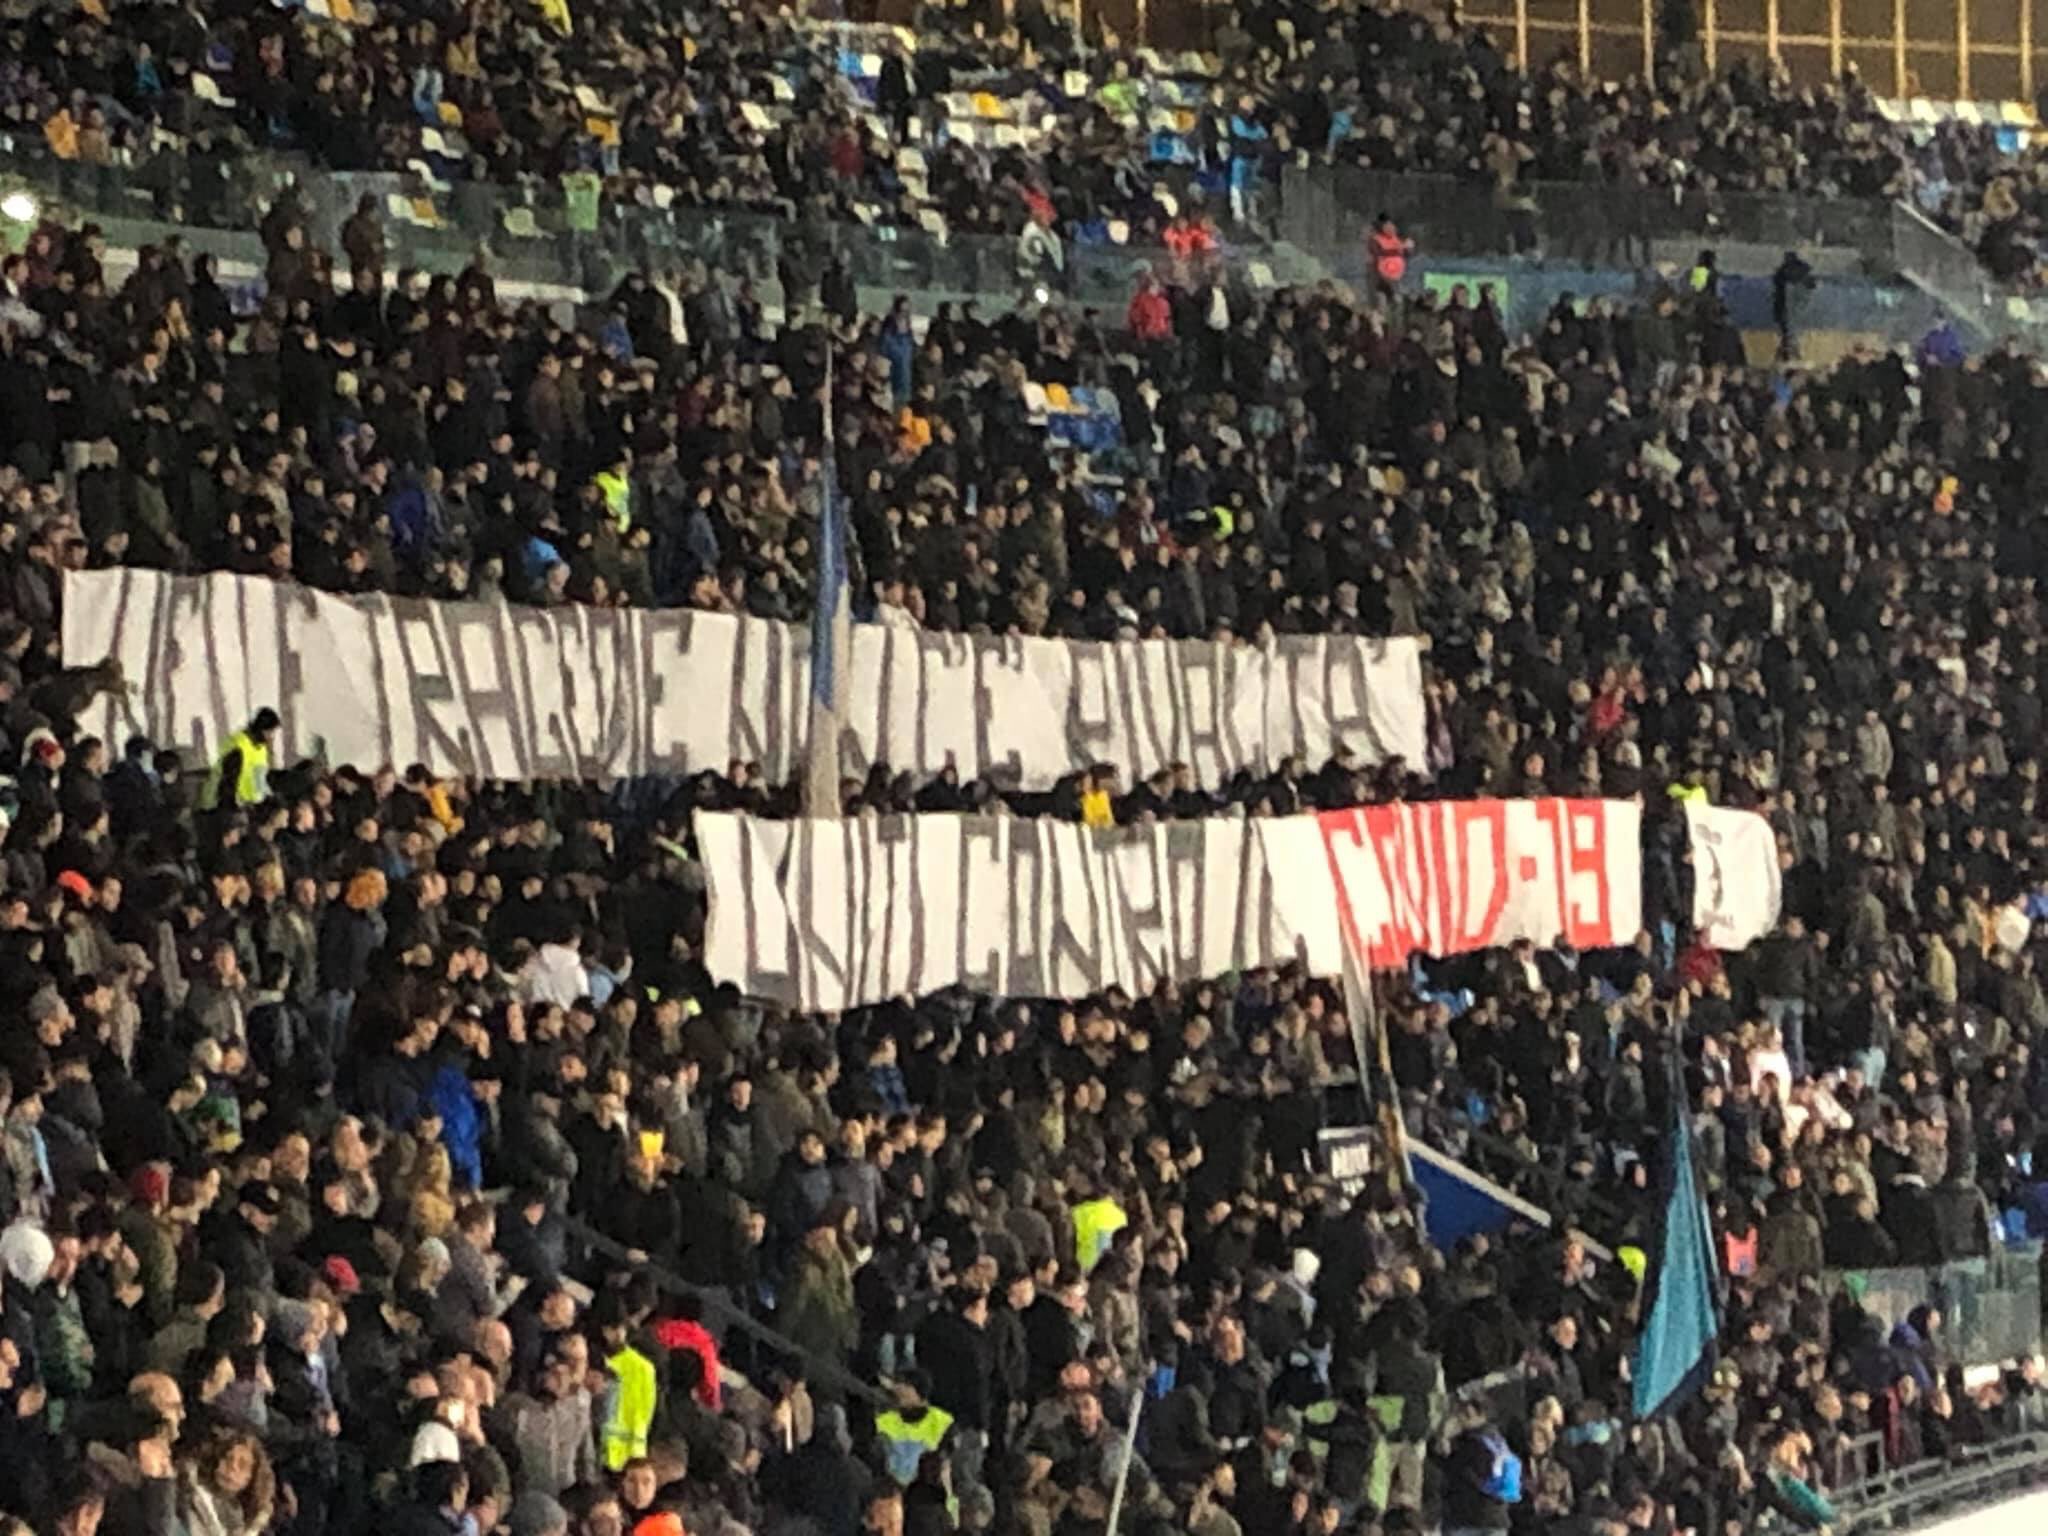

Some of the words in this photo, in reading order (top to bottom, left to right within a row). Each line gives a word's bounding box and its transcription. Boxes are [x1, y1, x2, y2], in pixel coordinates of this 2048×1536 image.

[738, 813, 924, 1010] UNITI
[955, 815, 1205, 995] CONTRO
[1318, 796, 1612, 968] COVID-19
